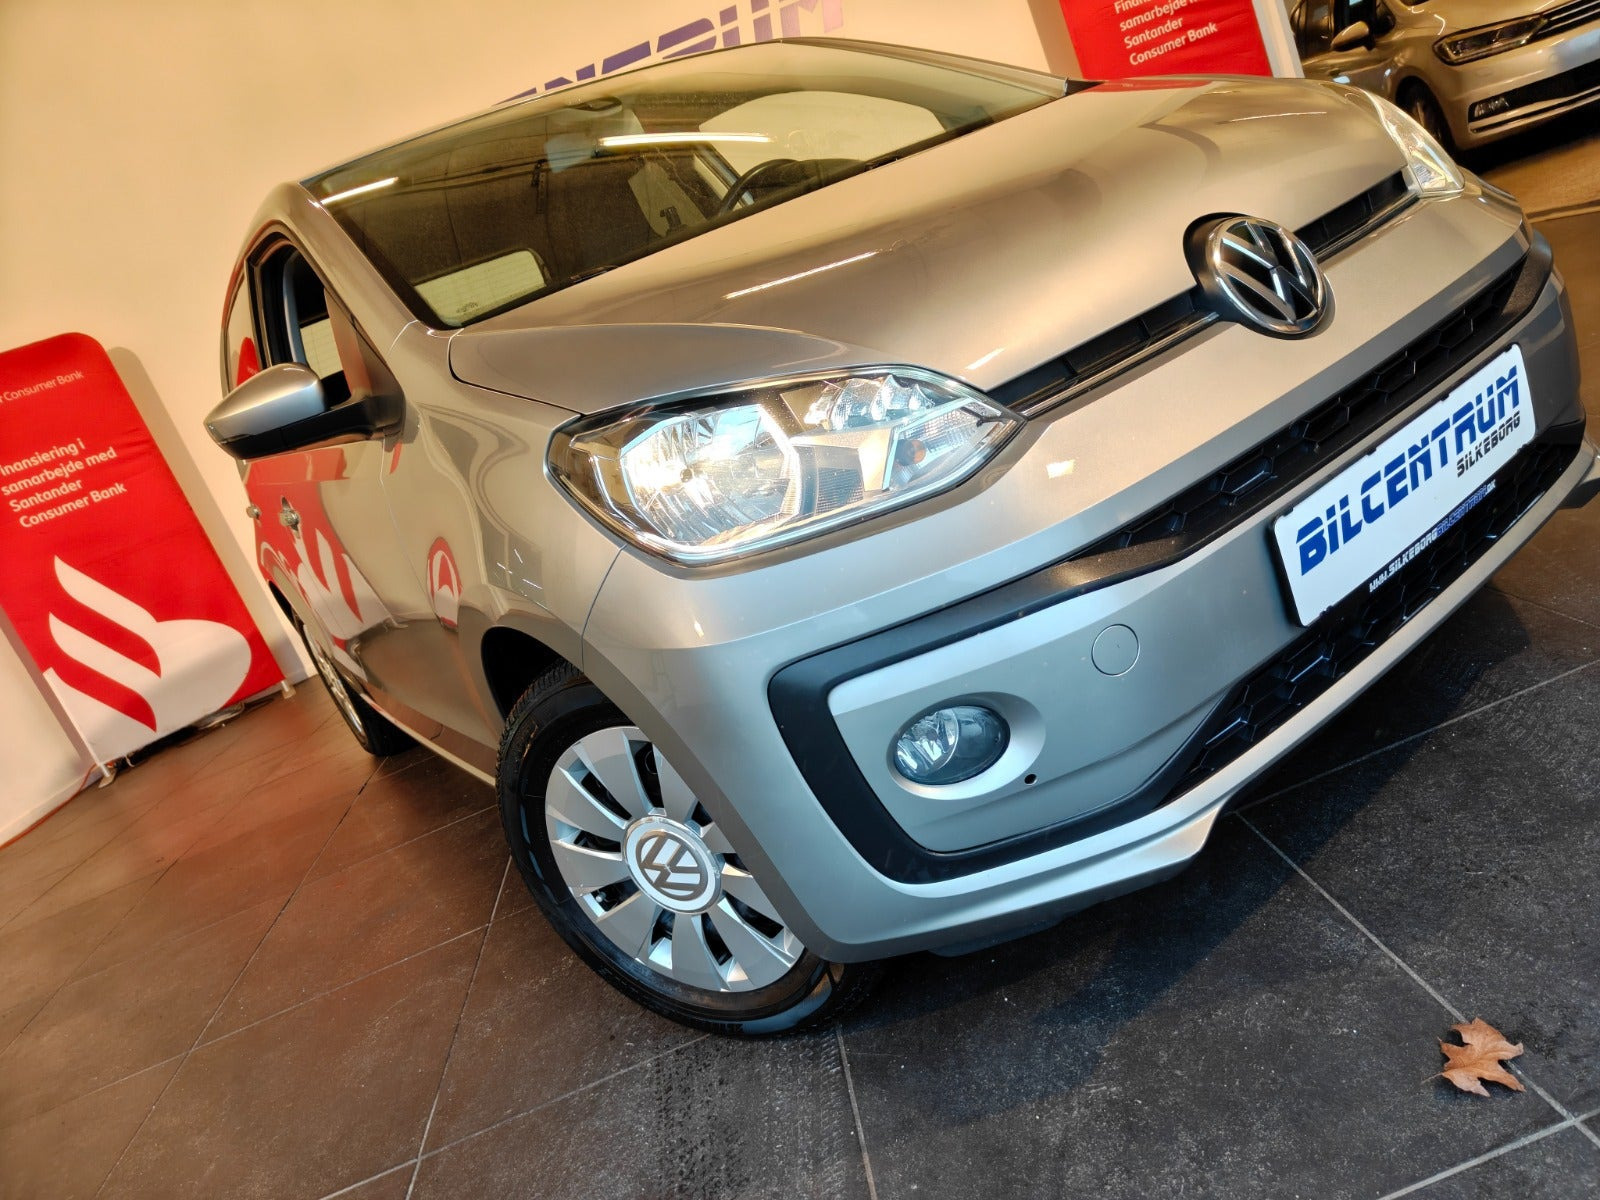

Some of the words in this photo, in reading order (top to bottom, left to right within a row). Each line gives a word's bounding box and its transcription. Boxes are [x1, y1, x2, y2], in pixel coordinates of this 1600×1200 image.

[1120, 0, 1187, 31] samarbejde
[1124, 18, 1183, 49] Santander
[1129, 36, 1186, 65] Consumer
[1187, 22, 1218, 42] Bank
[3, 378, 57, 401] Consumer
[57, 370, 84, 385] Bank
[76, 437, 86, 450] i
[1456, 411, 1521, 478] SILKEBORG
[1, 457, 85, 496] samarbejde
[85, 446, 117, 467] med
[1296, 365, 1520, 576] BILCENTRUM
[9, 479, 82, 512] Santander
[19, 496, 90, 528] Consumer
[90, 482, 127, 503] Bank
